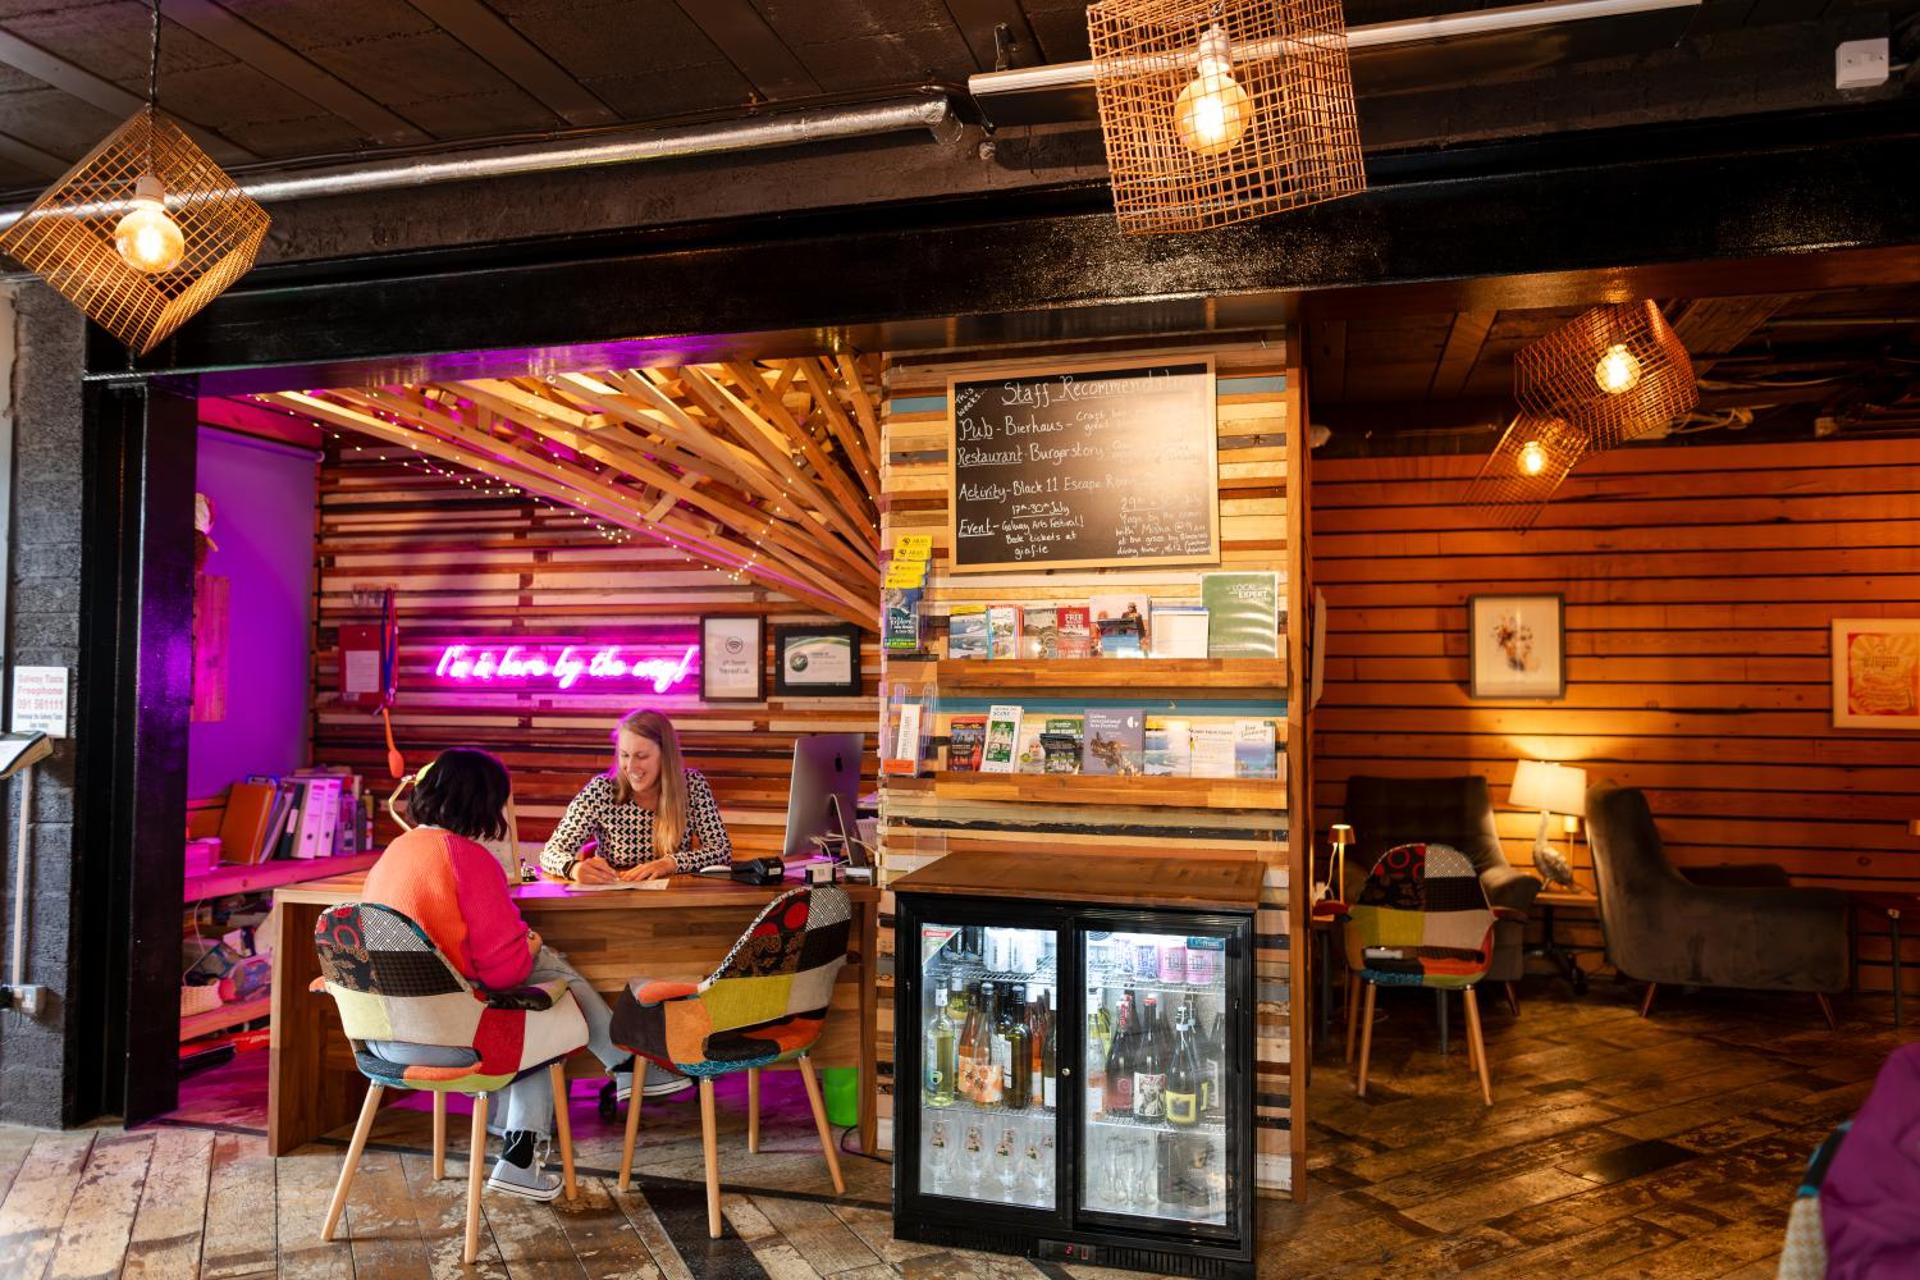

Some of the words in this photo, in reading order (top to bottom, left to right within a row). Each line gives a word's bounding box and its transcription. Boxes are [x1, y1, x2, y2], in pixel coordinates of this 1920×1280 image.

[1001, 382, 1050, 408] Staff
[959, 416, 994, 440] Pub
[1005, 414, 1063, 436] Bierhaus
[1013, 480, 1043, 496] Black
[1046, 476, 1059, 492] 11
[1001, 519, 1030, 536] Galway
[1032, 519, 1048, 529] Arts
[1005, 534, 1024, 545] Book
[1029, 532, 1061, 543] tickets
[1065, 530, 1077, 541] at
[552, 646, 583, 688] by
[589, 646, 627, 677] the
